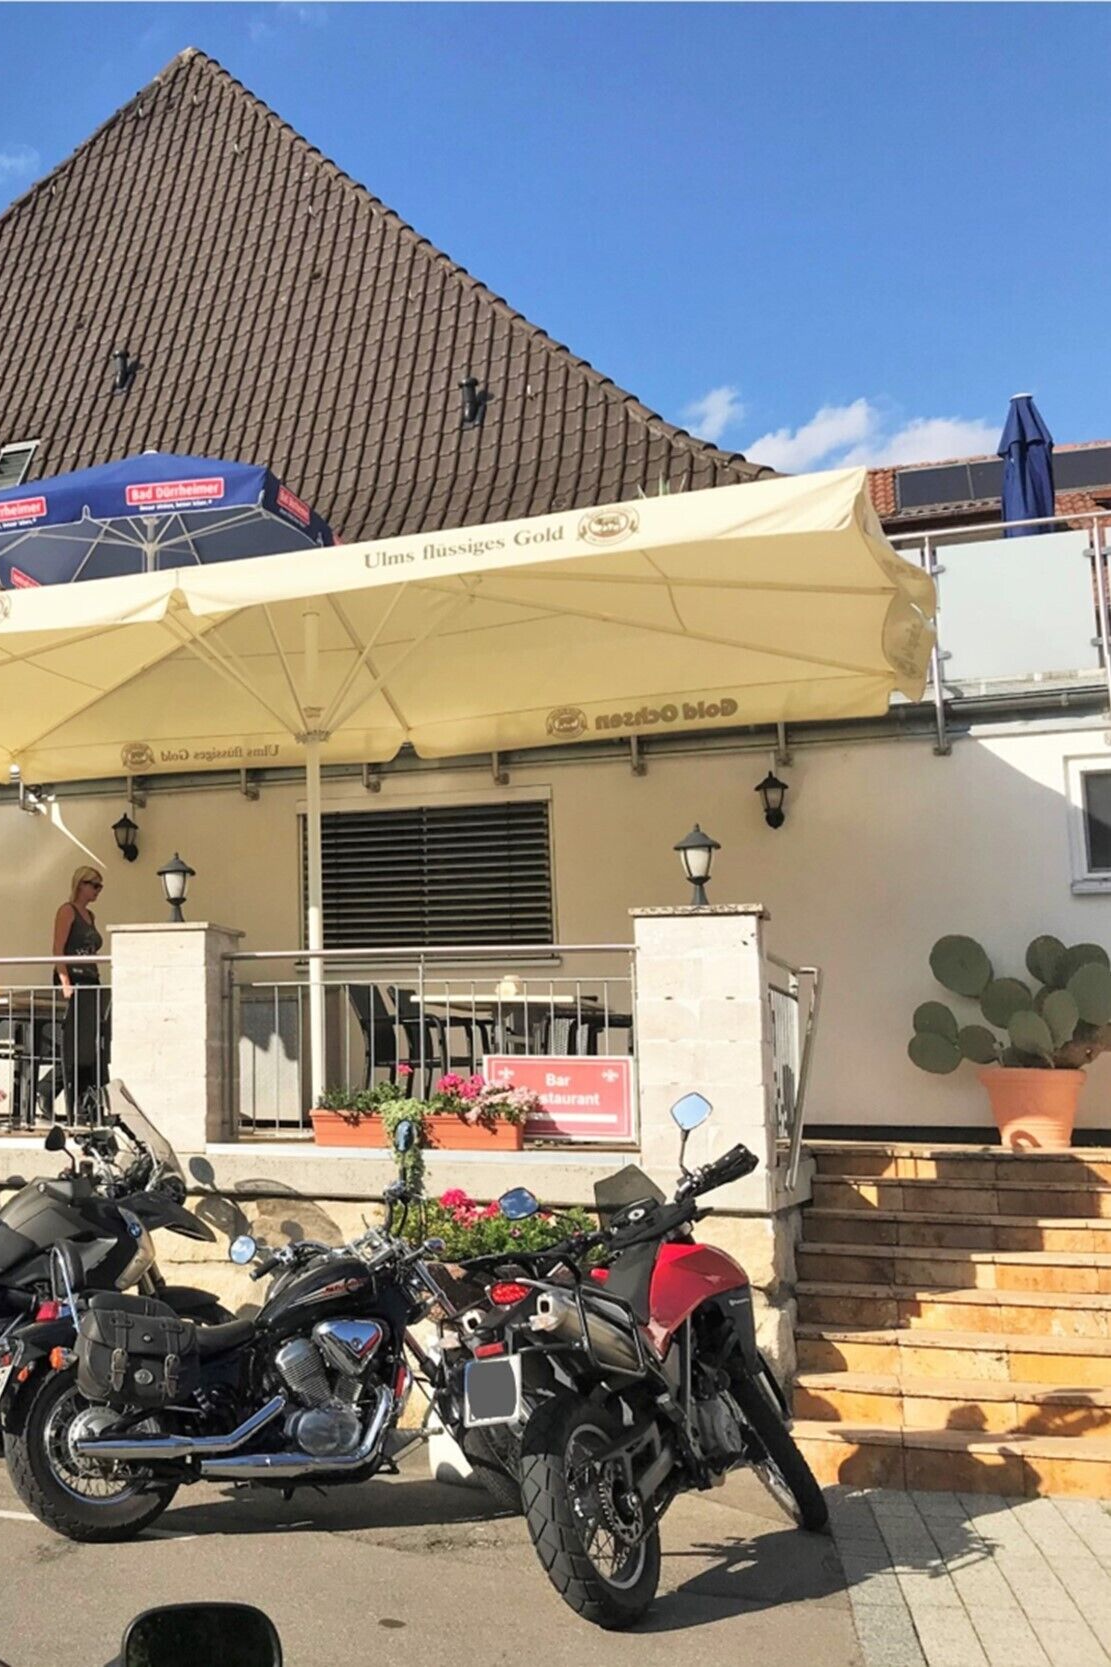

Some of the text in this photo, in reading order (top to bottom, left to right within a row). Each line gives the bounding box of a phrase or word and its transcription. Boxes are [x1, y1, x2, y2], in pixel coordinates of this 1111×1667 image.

[131, 483, 219, 502] Bad Dürrheimer
[364, 526, 564, 569] Ulms flüssiges Gold
[545, 1073, 571, 1087] Bar
[538, 1093, 599, 1106] staurant
